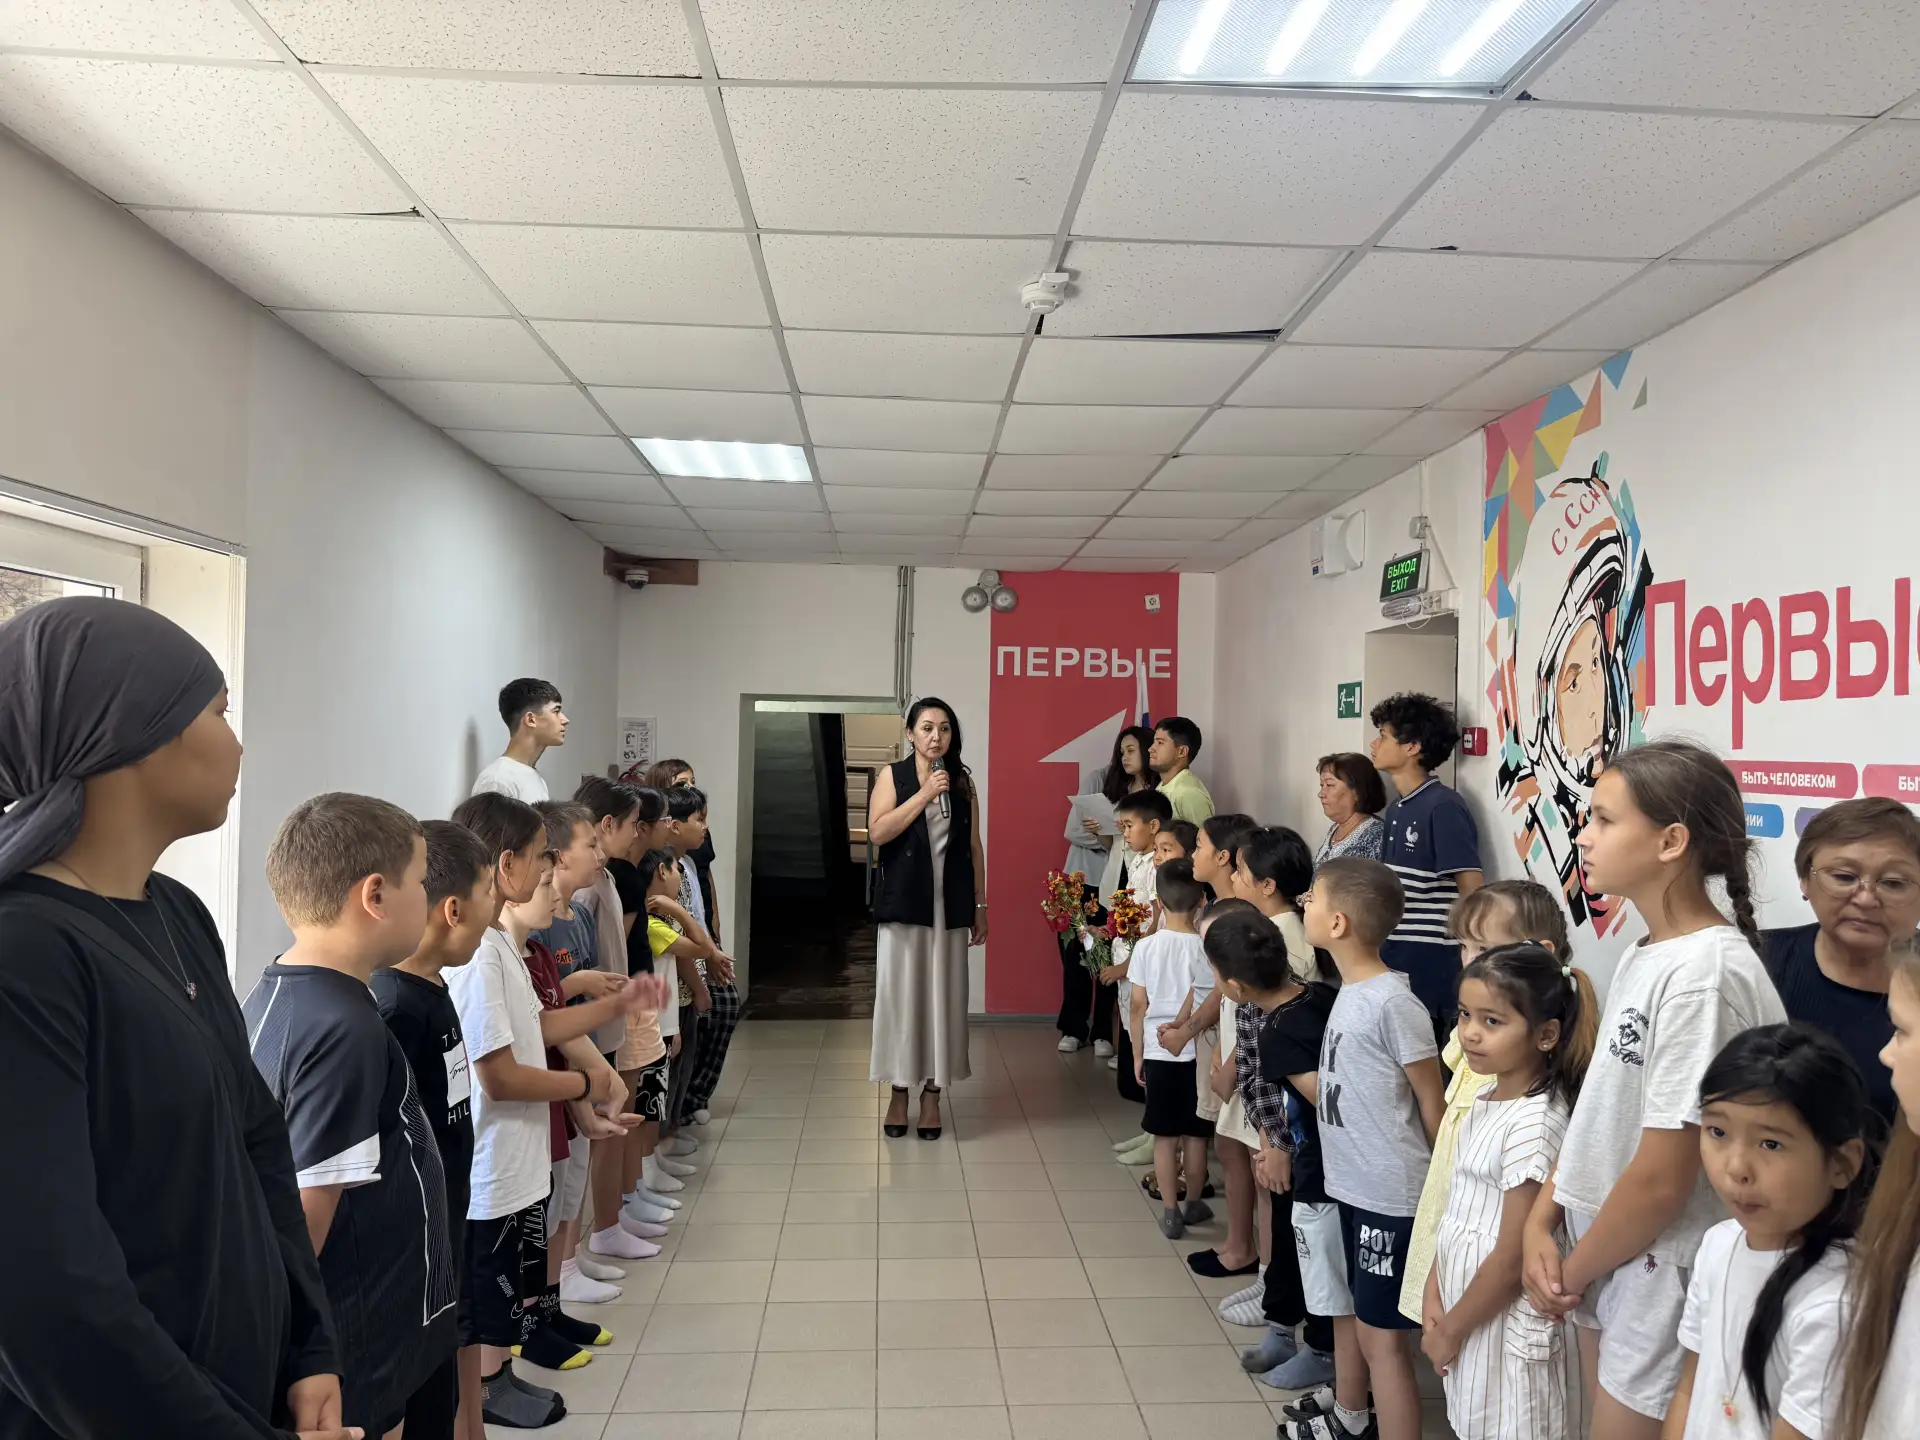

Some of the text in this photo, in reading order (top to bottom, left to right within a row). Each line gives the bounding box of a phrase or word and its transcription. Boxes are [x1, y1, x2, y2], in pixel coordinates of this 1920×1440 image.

[1387, 557, 1417, 579] ВЫХОД
[1390, 576, 1409, 593] EXIT
[996, 645, 1172, 679] ПЕРВЫЕ
[1645, 576, 1920, 750] Первы
[1741, 771, 1836, 789] БЫТЬ ЧЕЛОВЕКОМ
[1898, 776, 1920, 792] БЫ
[1359, 1224, 1396, 1254] BOY
